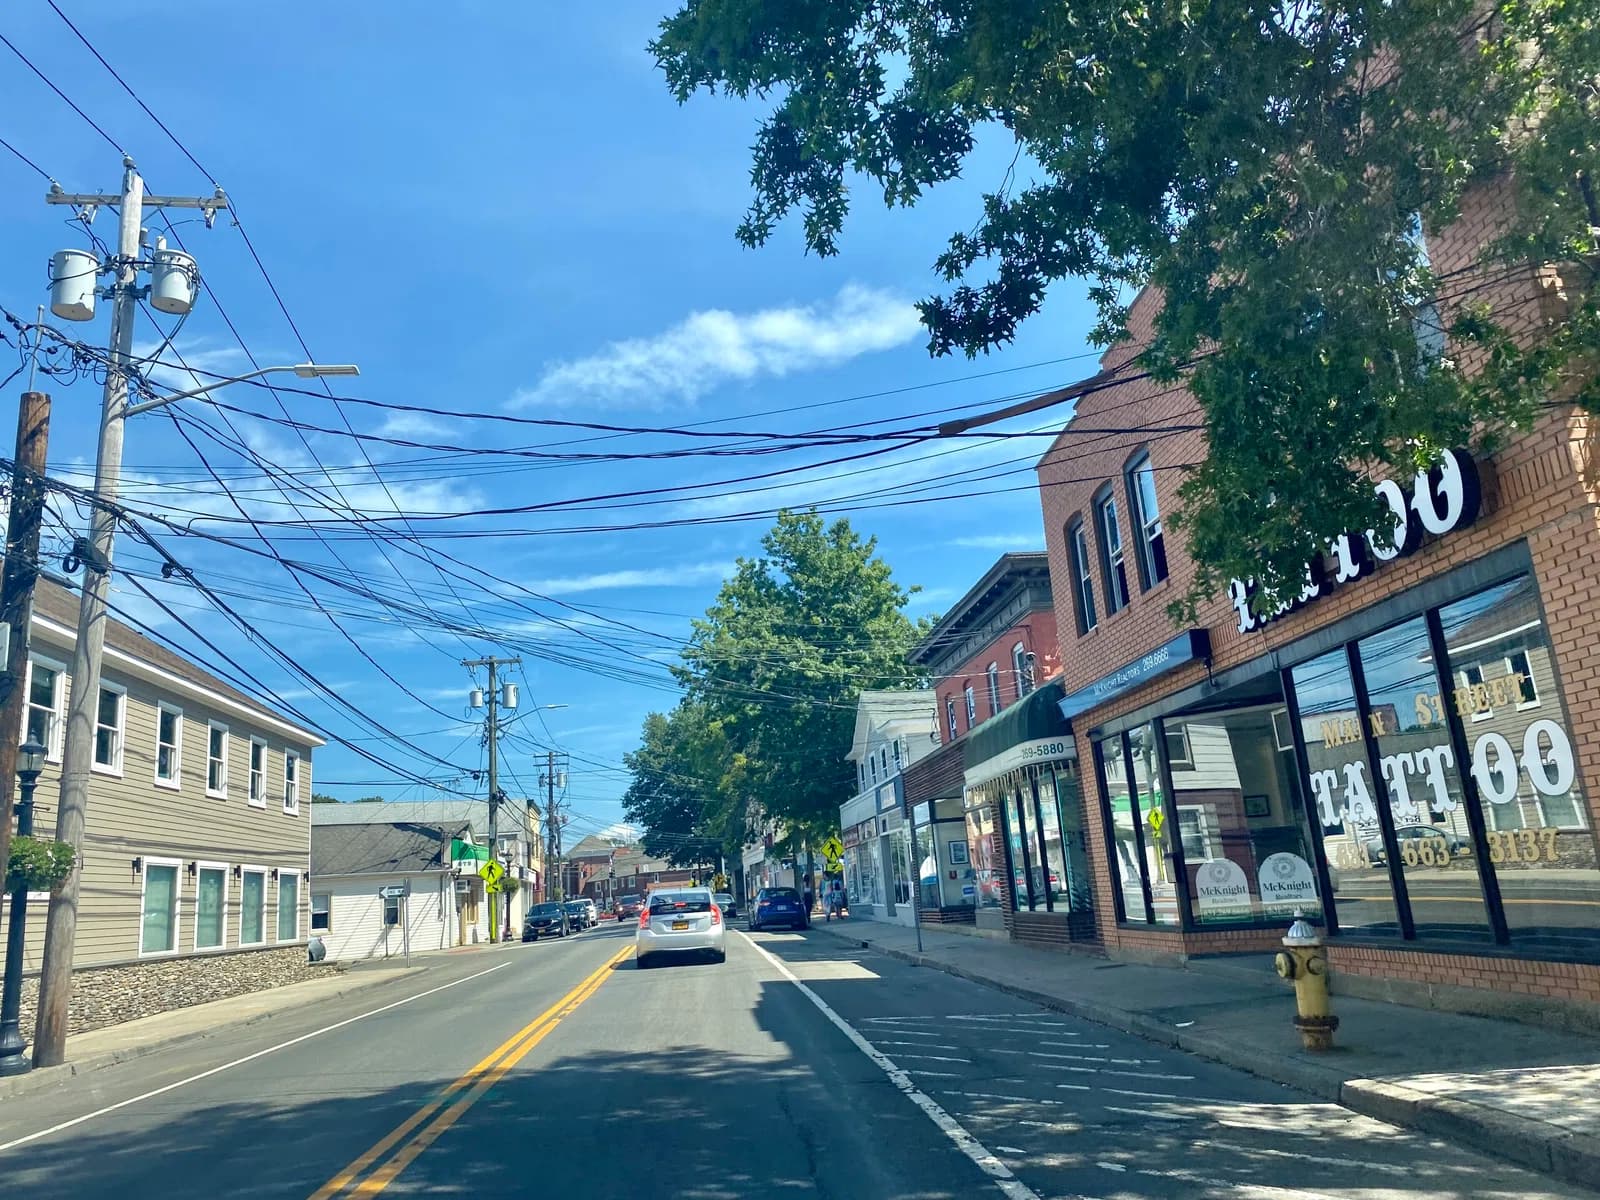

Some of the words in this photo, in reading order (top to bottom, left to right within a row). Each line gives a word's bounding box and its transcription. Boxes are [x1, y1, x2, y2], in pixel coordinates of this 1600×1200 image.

[1228, 448, 1463, 634] TTOO
[1320, 711, 1386, 749] MAIN
[1414, 672, 1525, 725] STREET
[1021, 742, 1064, 759] 269-5880
[1309, 719, 1575, 827] TATTOO
[1402, 836, 1450, 867] 663
[1486, 826, 1560, 863] 3137
[1200, 885, 1246, 896] McKnight
[1261, 881, 1312, 892] McKnight
